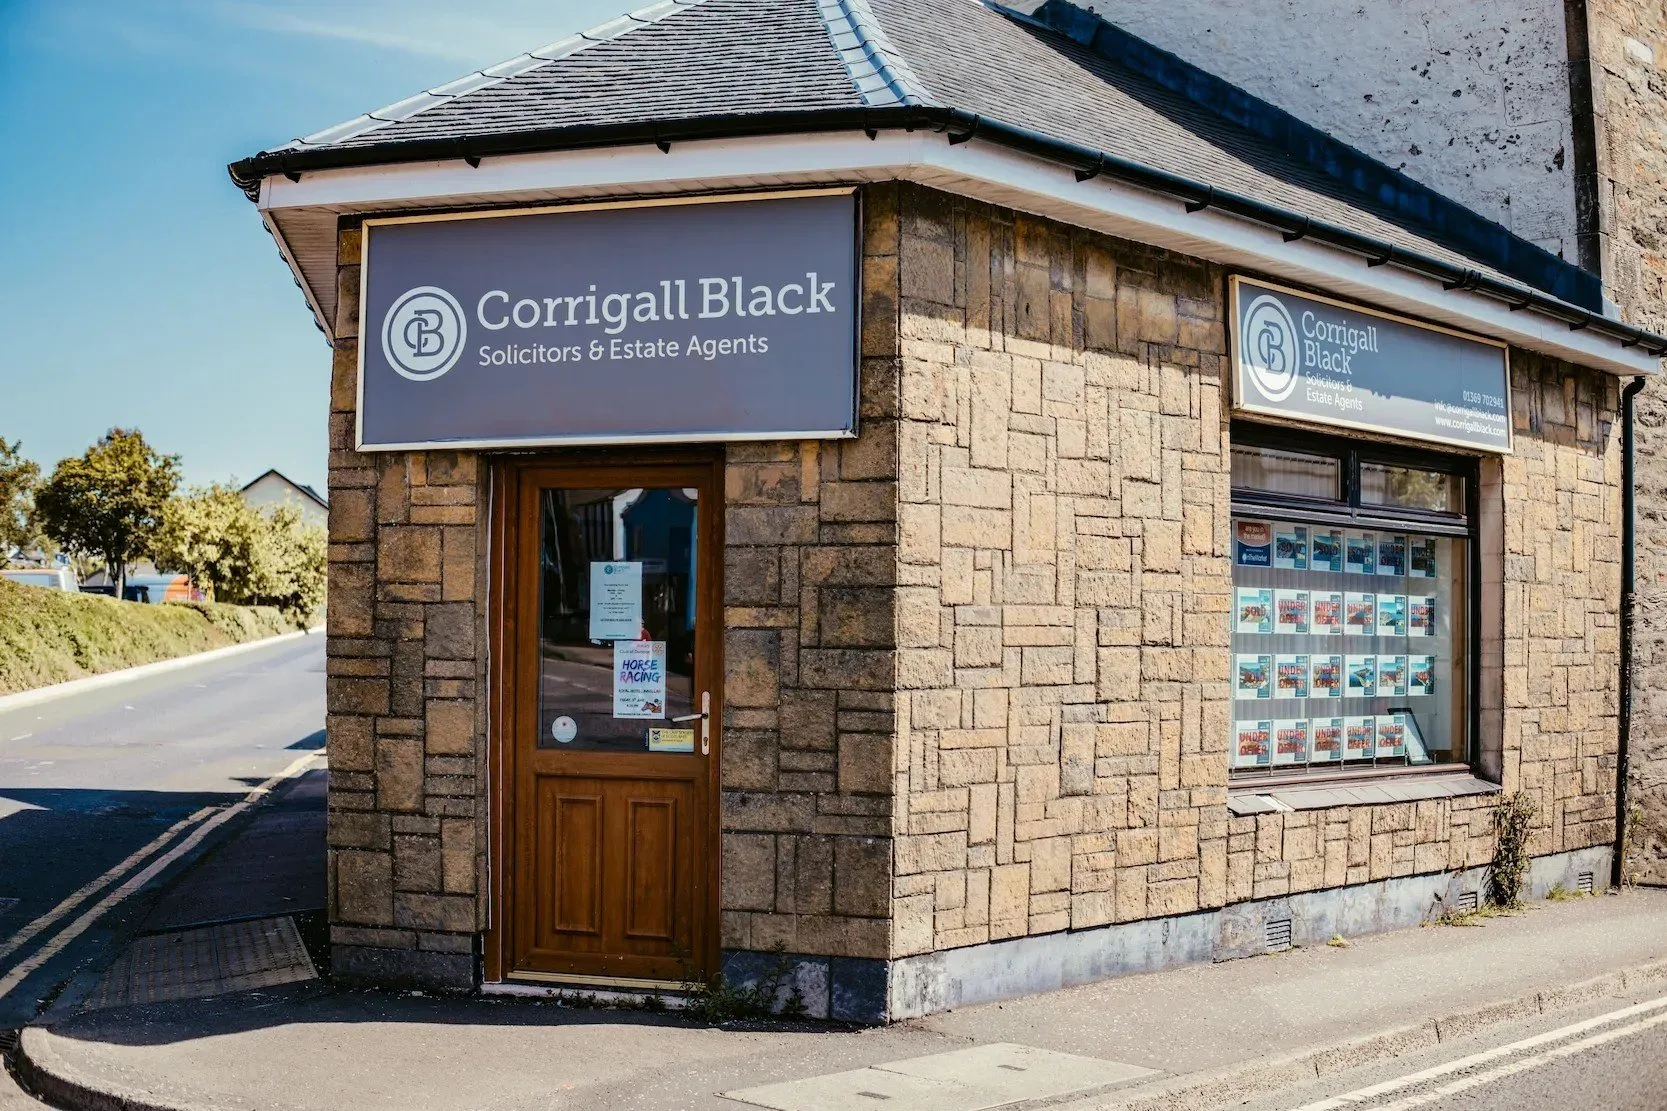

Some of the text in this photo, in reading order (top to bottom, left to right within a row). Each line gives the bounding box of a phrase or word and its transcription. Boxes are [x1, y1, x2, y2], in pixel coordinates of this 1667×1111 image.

[476, 271, 836, 335] Corrigall Black
[1301, 310, 1379, 355] Corrigall
[478, 334, 769, 367] Solicitors & Estate Agents
[1303, 339, 1352, 375] Black
[1305, 371, 1353, 392] Solicitors &
[1306, 387, 1363, 411] Estate Agents
[1462, 390, 1482, 404] 01369
[1434, 416, 1507, 438] www.corrigallblack.com
[1278, 599, 1306, 611] UNDER
[622, 659, 658, 672] HORSE
[620, 671, 661, 684] RACING
[1239, 731, 1269, 742] UNDER
[1277, 729, 1305, 741] UNDER
[1315, 727, 1341, 739] UNDER
